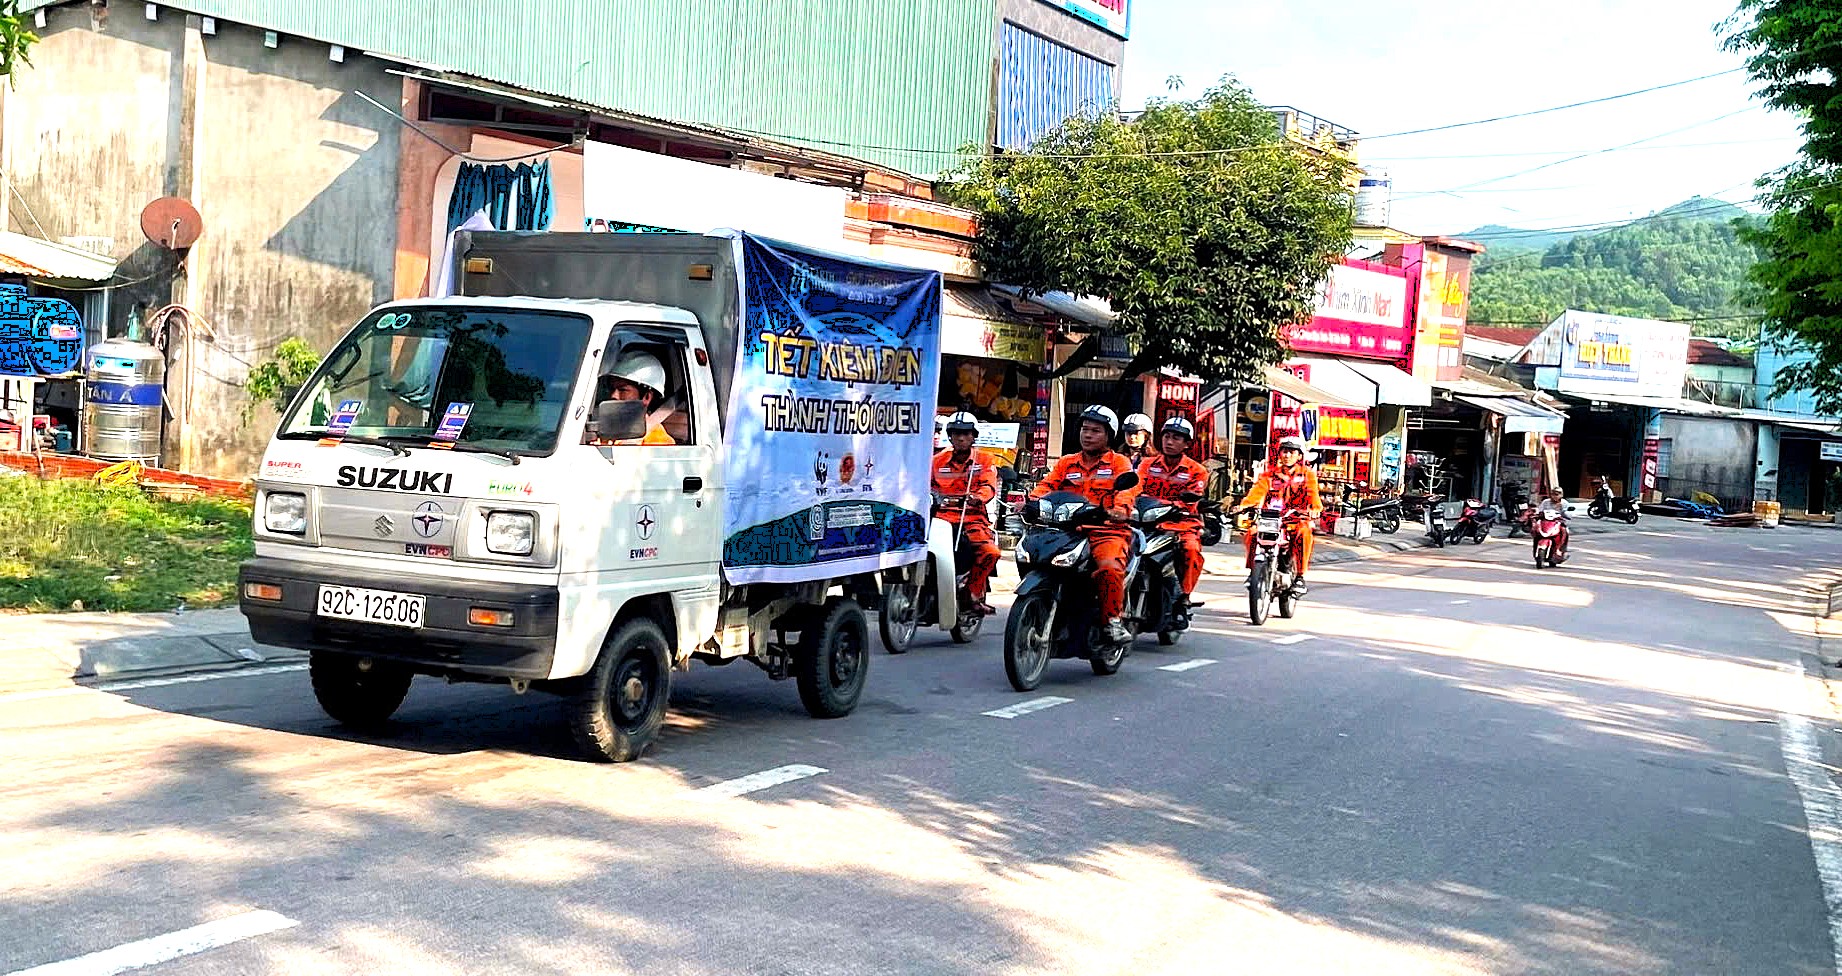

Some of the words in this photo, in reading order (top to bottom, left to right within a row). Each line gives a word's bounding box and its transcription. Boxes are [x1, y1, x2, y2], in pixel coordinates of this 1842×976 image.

[818, 338, 876, 388] KIỆM
[1161, 385, 1195, 400] HON
[762, 389, 831, 432] THÀNH
[832, 395, 875, 434] THÓI
[875, 400, 920, 433] QUEN
[267, 460, 302, 469] SUPER
[337, 465, 452, 494] SUZUKI
[321, 589, 419, 624] 92C-126.06
